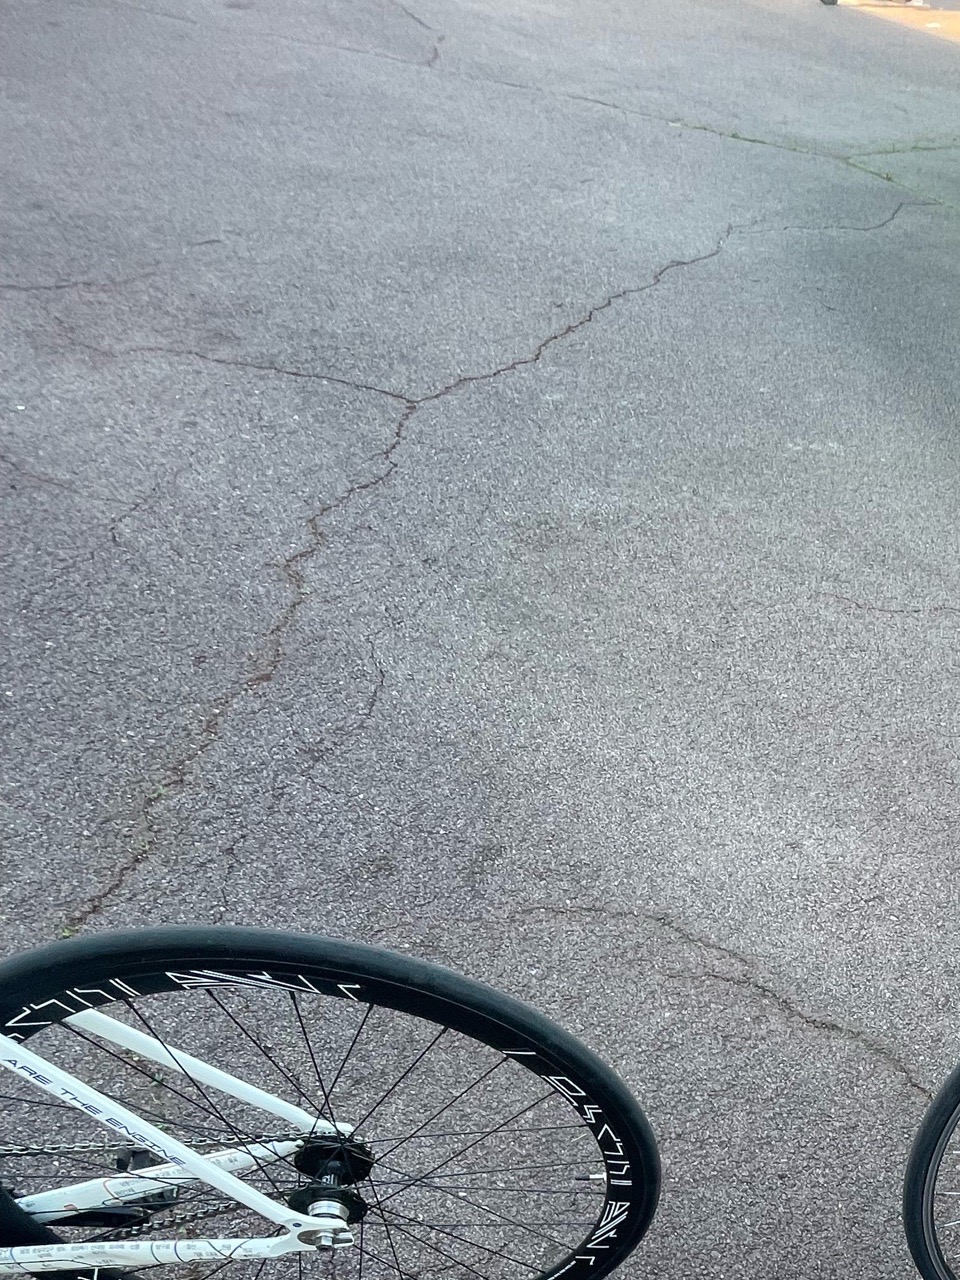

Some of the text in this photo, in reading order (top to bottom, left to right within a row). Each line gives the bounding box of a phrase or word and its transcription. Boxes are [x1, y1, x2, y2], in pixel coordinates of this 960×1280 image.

[2, 1058, 186, 1166] ARE THE ENGINE
